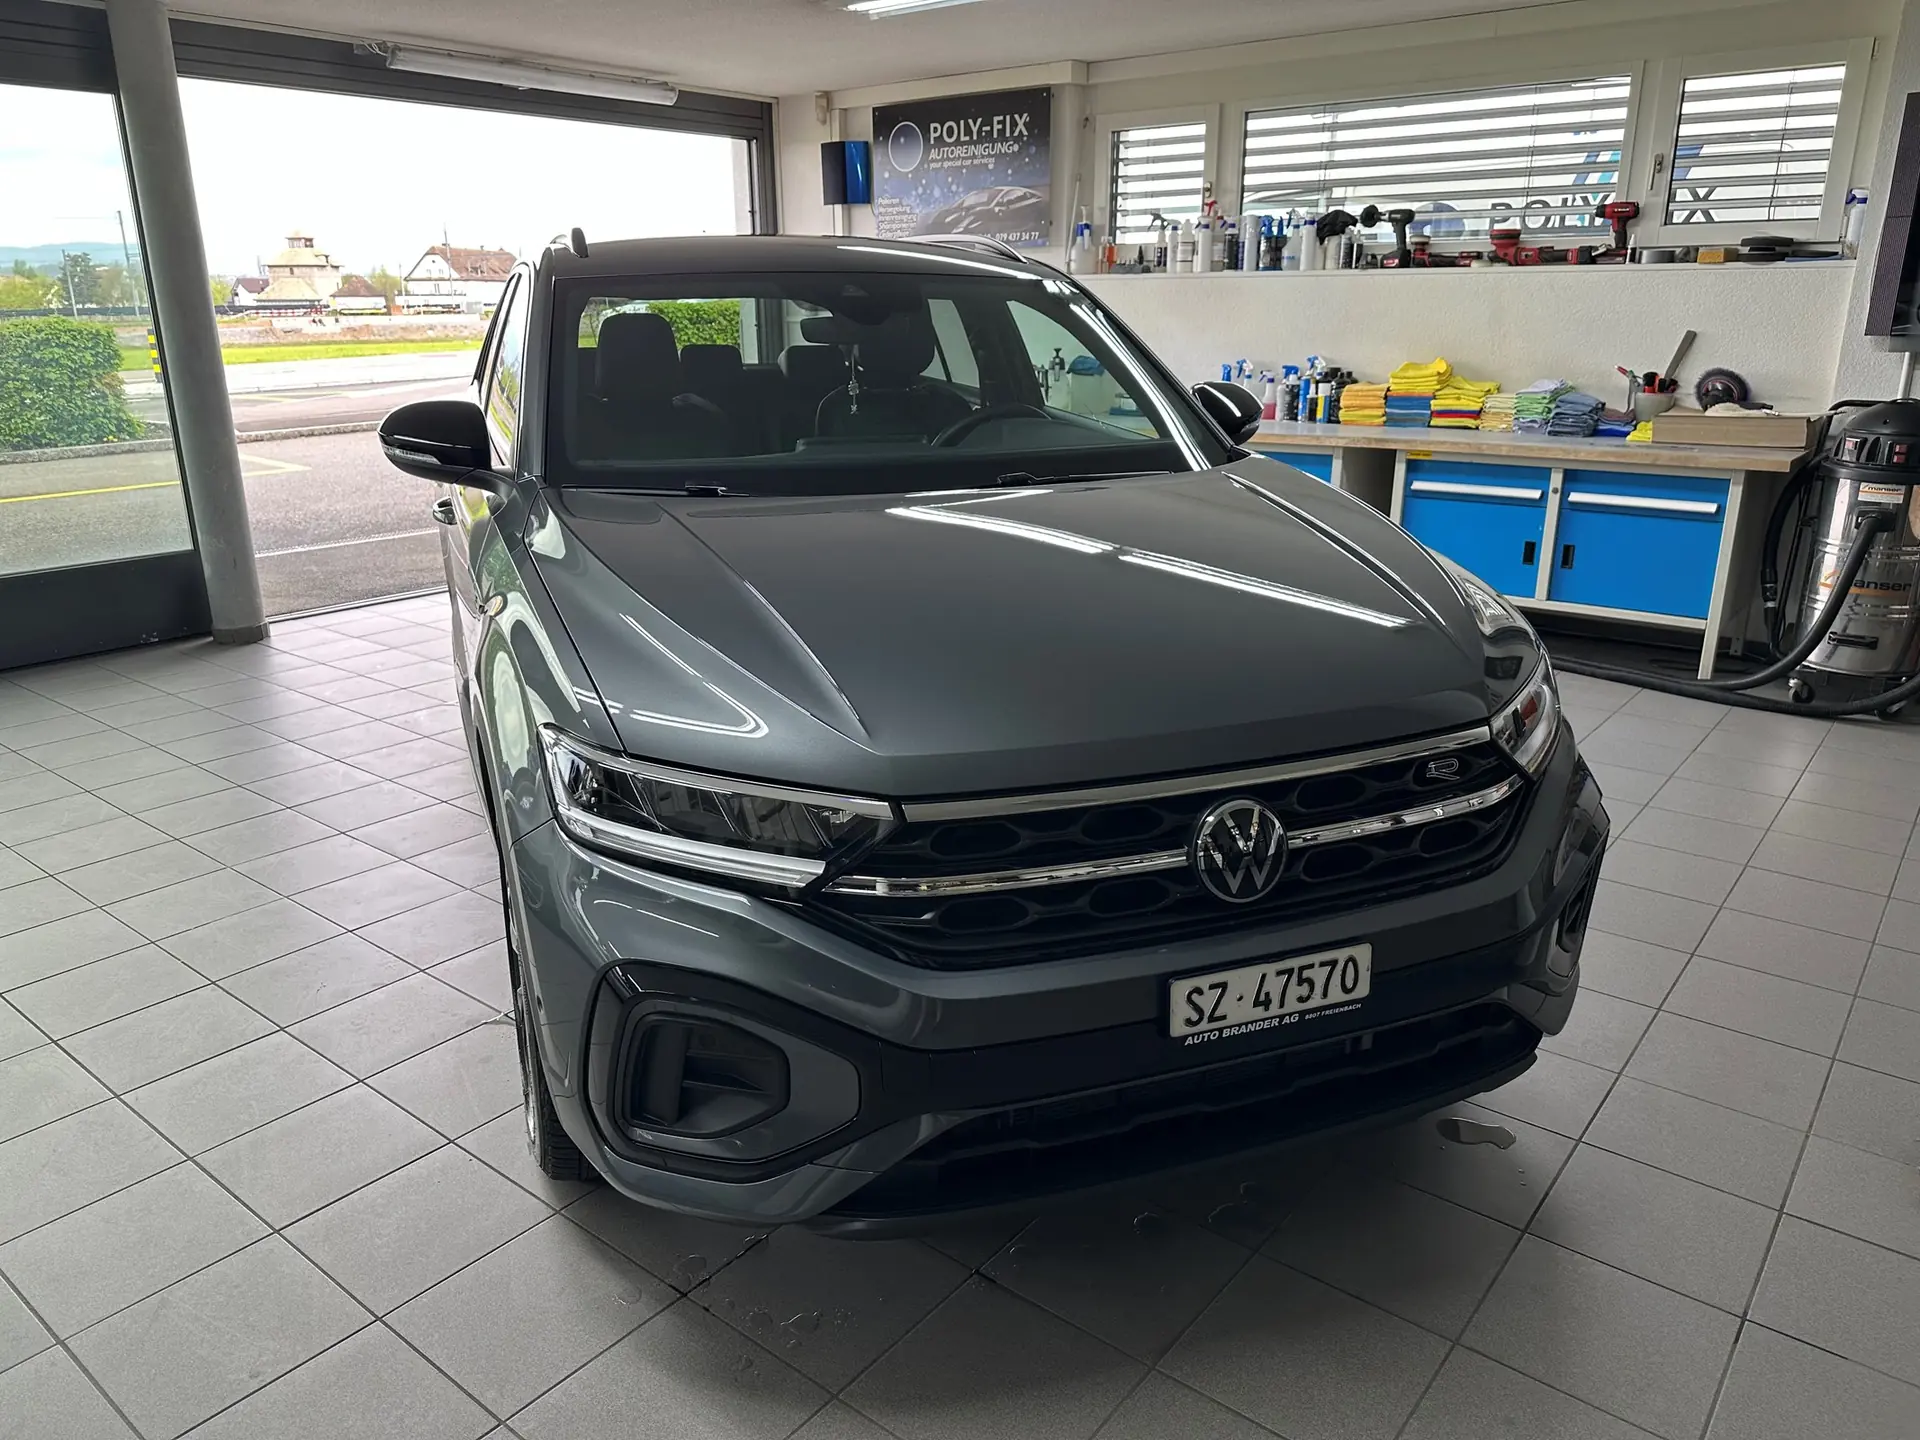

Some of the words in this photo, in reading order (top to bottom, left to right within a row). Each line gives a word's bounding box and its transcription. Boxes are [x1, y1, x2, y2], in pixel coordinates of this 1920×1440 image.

[929, 113, 1028, 144] POLY-FIX
[928, 141, 1014, 160] AUTOREINIGUNG
[943, 158, 961, 169] special
[962, 158, 972, 166] car
[1021, 232, 1029, 240] 34
[1852, 579, 1912, 592] anser
[1184, 980, 1228, 1028] SZ
[1251, 954, 1359, 1012] 47570
[1184, 1030, 1220, 1046] AUTO
[1222, 1017, 1280, 1038] BRANDER
[1281, 1013, 1300, 1025] AG
[1321, 1003, 1362, 1017] FREIENBACH
